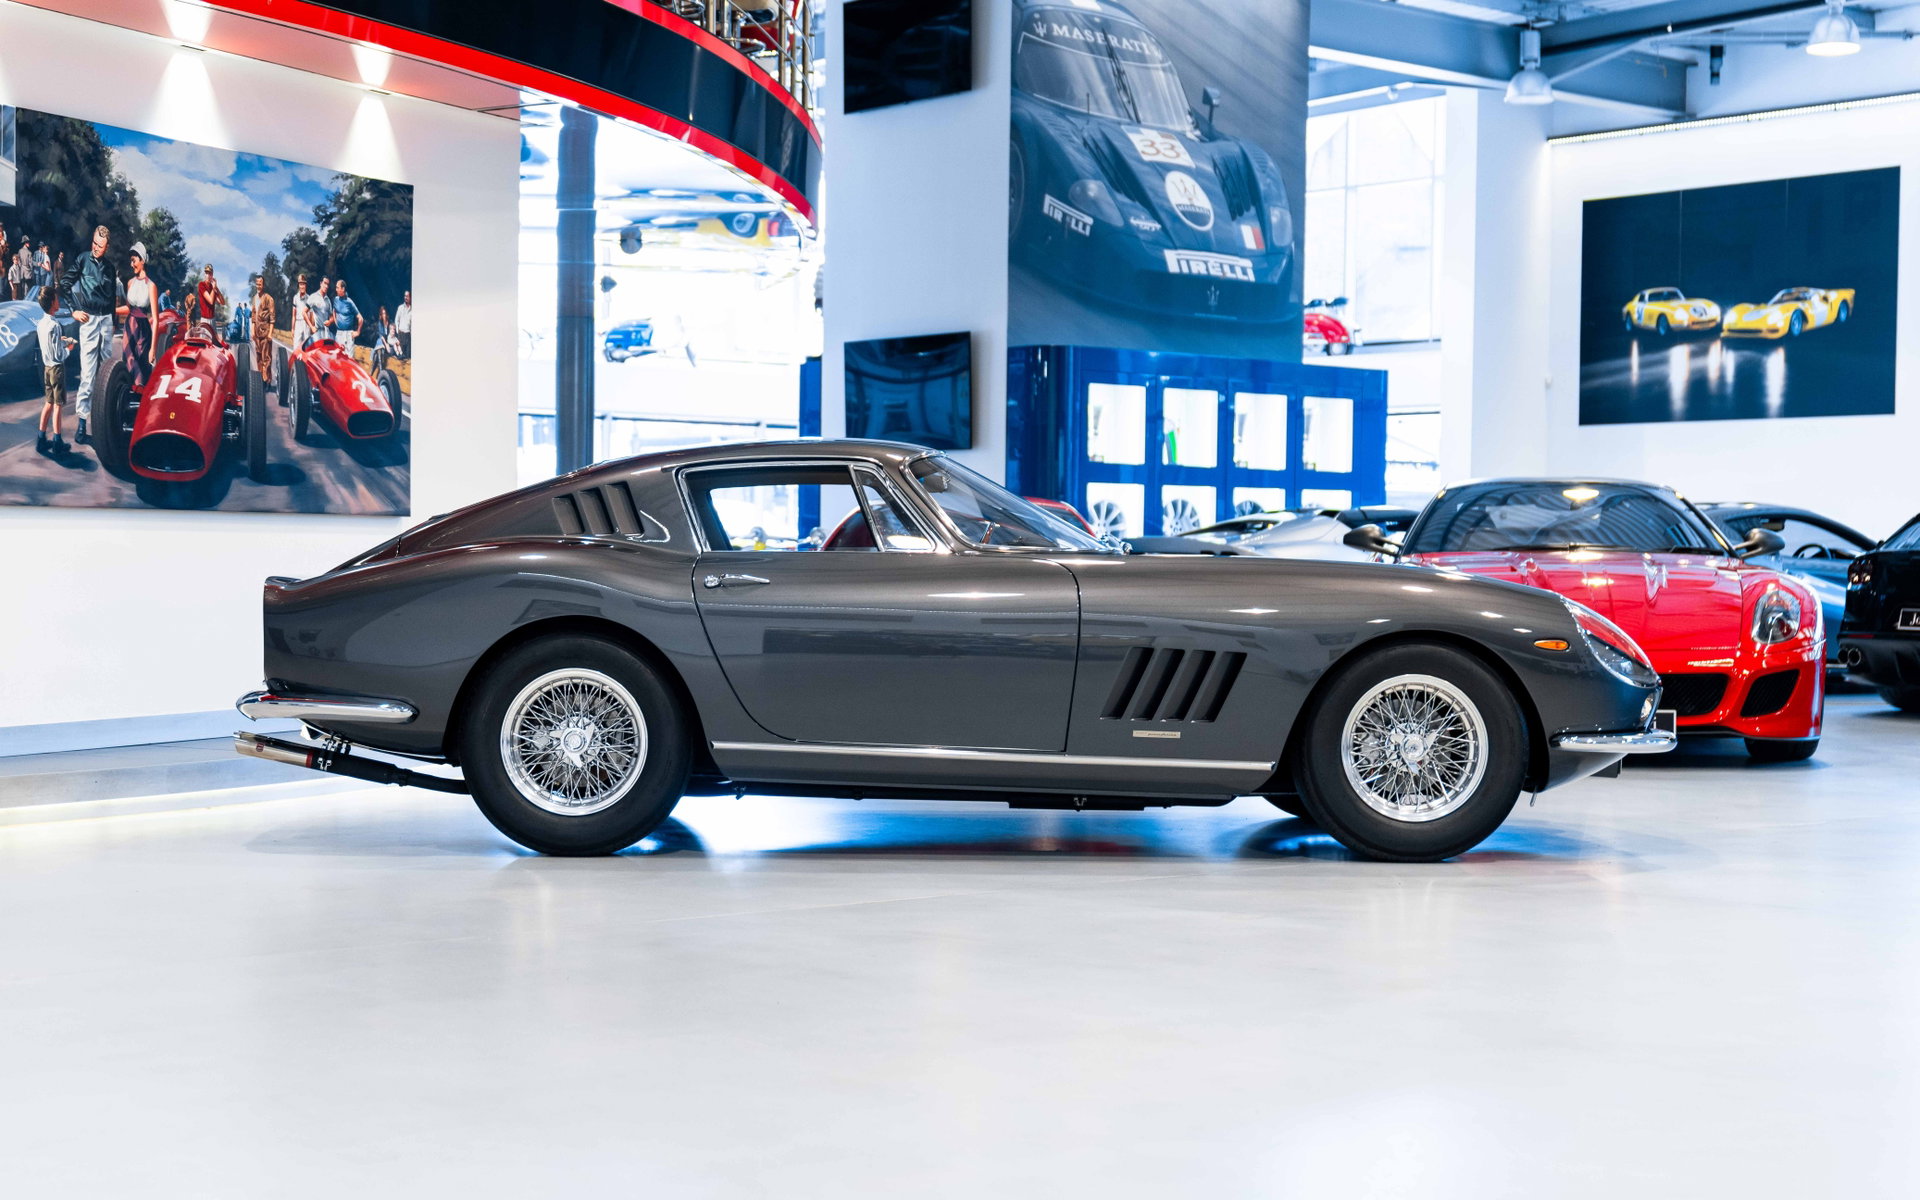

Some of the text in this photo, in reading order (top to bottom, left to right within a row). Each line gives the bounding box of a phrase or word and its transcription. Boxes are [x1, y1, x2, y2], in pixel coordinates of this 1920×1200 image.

[1052, 23, 1152, 56] MASERATI
[1139, 138, 1181, 159] 33
[1043, 193, 1093, 237] PIRLLI
[1163, 249, 1256, 282] PIRELLI
[150, 374, 202, 404] 14
[352, 380, 374, 403] 2
